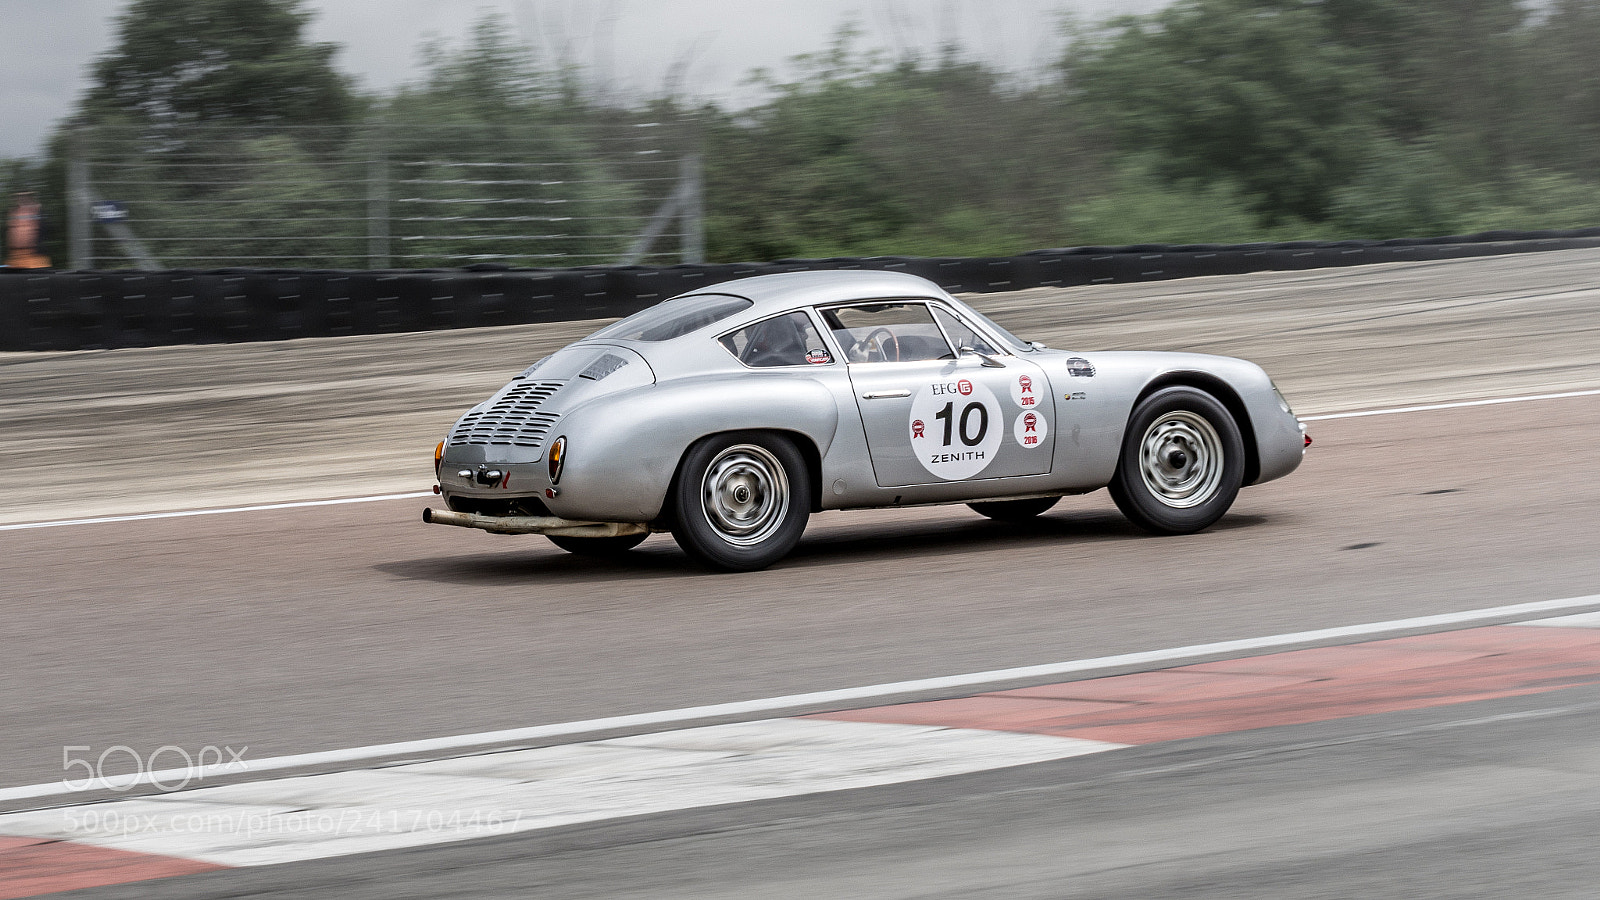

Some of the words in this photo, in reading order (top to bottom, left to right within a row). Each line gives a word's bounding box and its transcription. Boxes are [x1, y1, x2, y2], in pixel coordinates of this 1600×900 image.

[931, 383, 957, 396] EFG
[1021, 396, 1035, 406] 2015
[935, 401, 989, 447] 10
[1024, 436, 1038, 445] 2016
[931, 451, 985, 464] ZENITH
